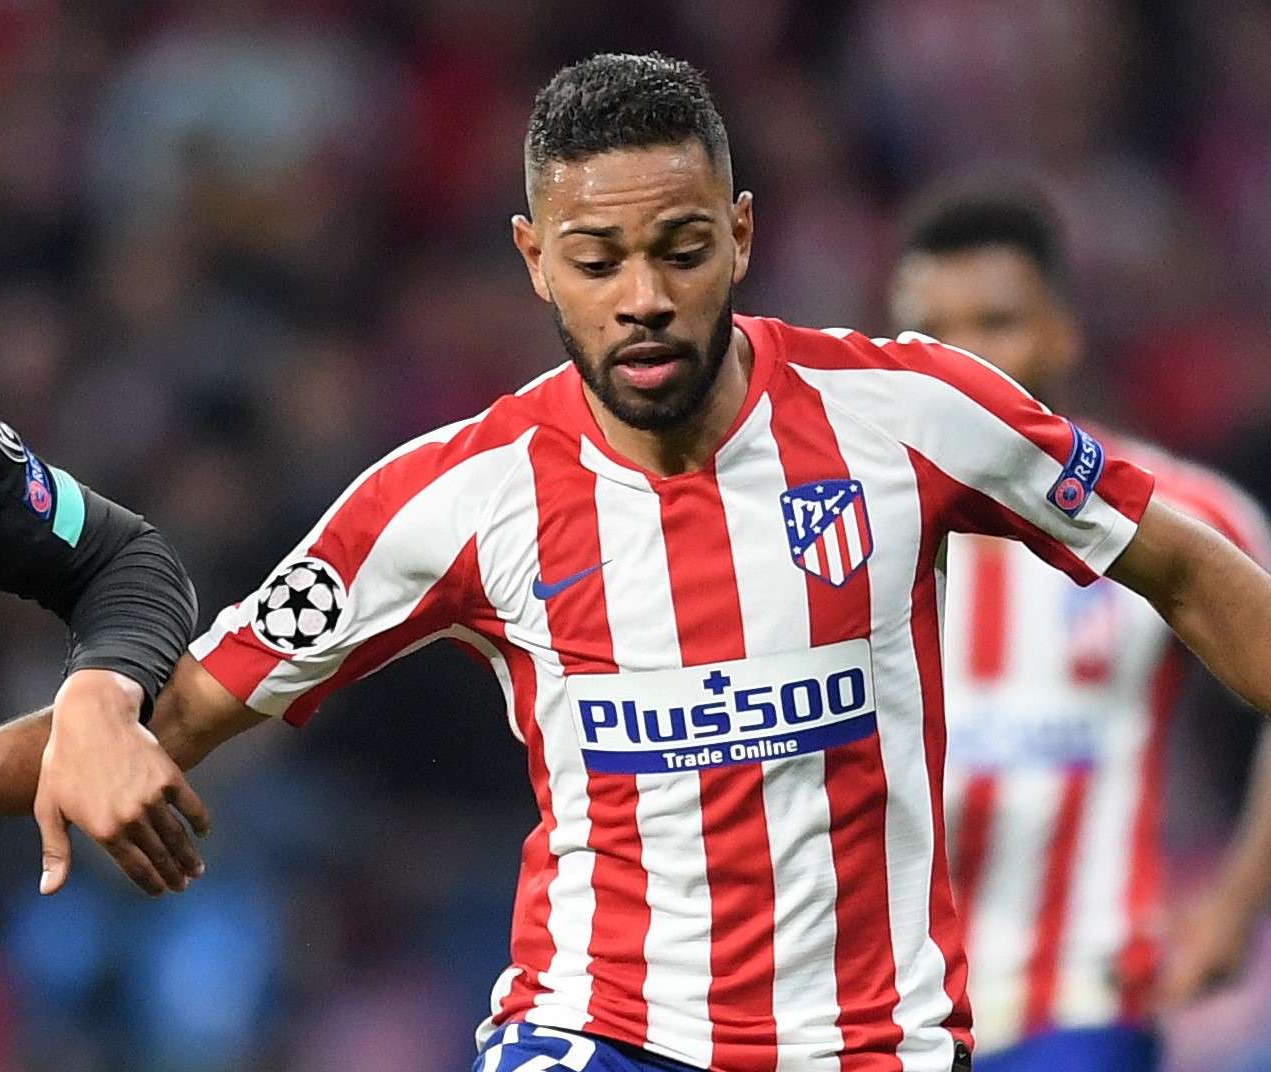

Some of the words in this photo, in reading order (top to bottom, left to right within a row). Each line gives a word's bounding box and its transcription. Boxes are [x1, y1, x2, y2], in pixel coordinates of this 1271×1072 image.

[578, 667, 866, 743] Plus500
[662, 749, 723, 769] Trade
[729, 739, 798, 761] Online
